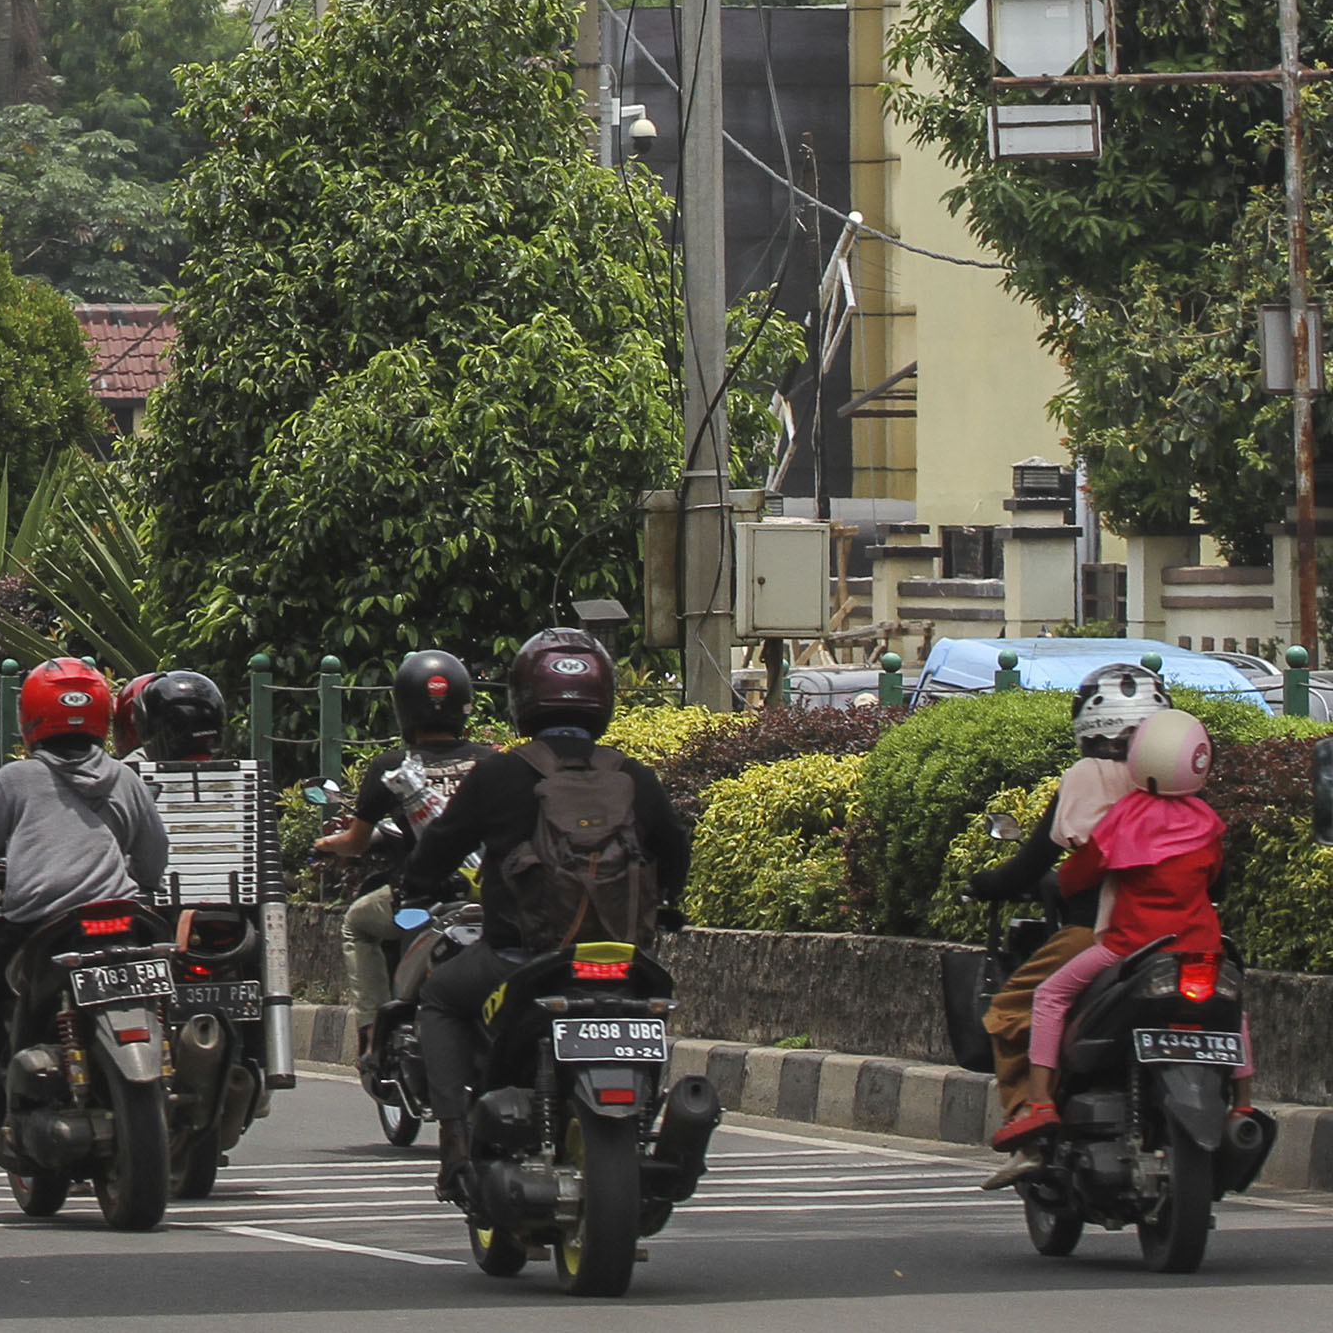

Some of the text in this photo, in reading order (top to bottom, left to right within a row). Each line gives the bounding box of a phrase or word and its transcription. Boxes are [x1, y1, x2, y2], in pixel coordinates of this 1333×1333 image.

[186, 987, 220, 1003] 3577
[556, 1023, 662, 1039] F 4098 UBC
[1141, 1033, 1153, 1047] B
[1158, 1034, 1201, 1048] 4343
[614, 1046, 662, 1057] 03-24
